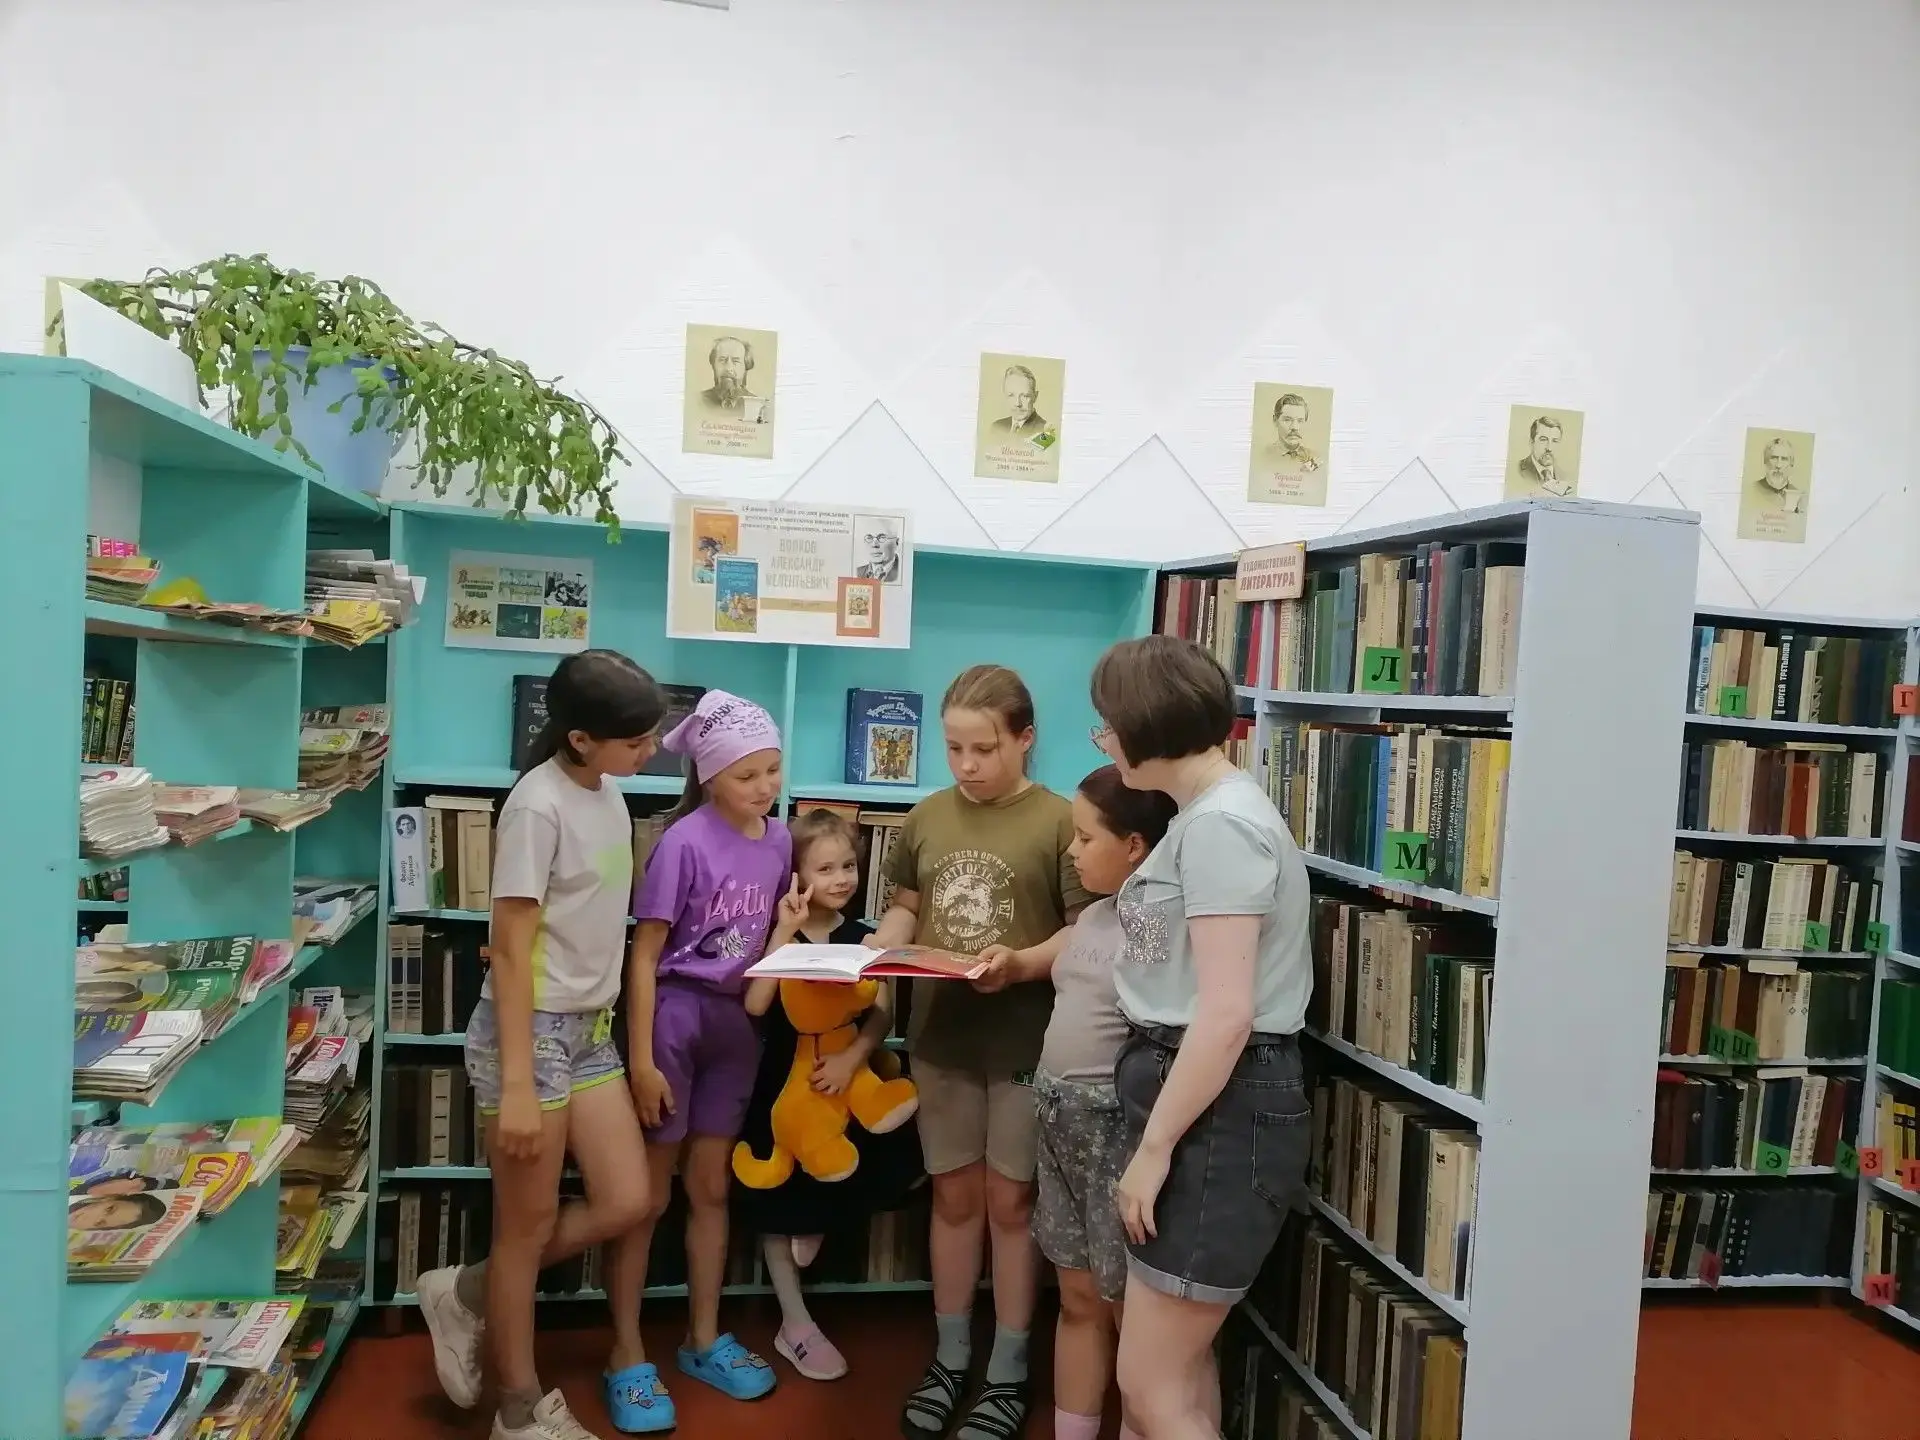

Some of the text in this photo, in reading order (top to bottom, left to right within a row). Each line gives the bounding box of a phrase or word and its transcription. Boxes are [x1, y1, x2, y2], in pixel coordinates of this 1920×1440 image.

[780, 539, 816, 553] ВОЛКОВ
[771, 556, 824, 572] АЛЕКСАНДР
[1242, 556, 1297, 572] ХУДОЖЕСТВЕННАЯ
[1240, 572, 1295, 591] ЛИТЕРАТУРА
[1371, 655, 1401, 682] Л
[1729, 694, 1740, 711] Т
[1900, 692, 1913, 707] Г
[1430, 767, 1441, 822] МЕЛЬНИКОВ
[1448, 769, 1459, 823] МЕЛЬНИКОВ
[980, 851, 1015, 878] OUTPOST
[1394, 842, 1428, 870] М
[407, 855, 416, 886] Абрамов
[705, 884, 769, 930] Pretty
[1766, 1151, 1782, 1169] Э
[1864, 1152, 1877, 1169] З
